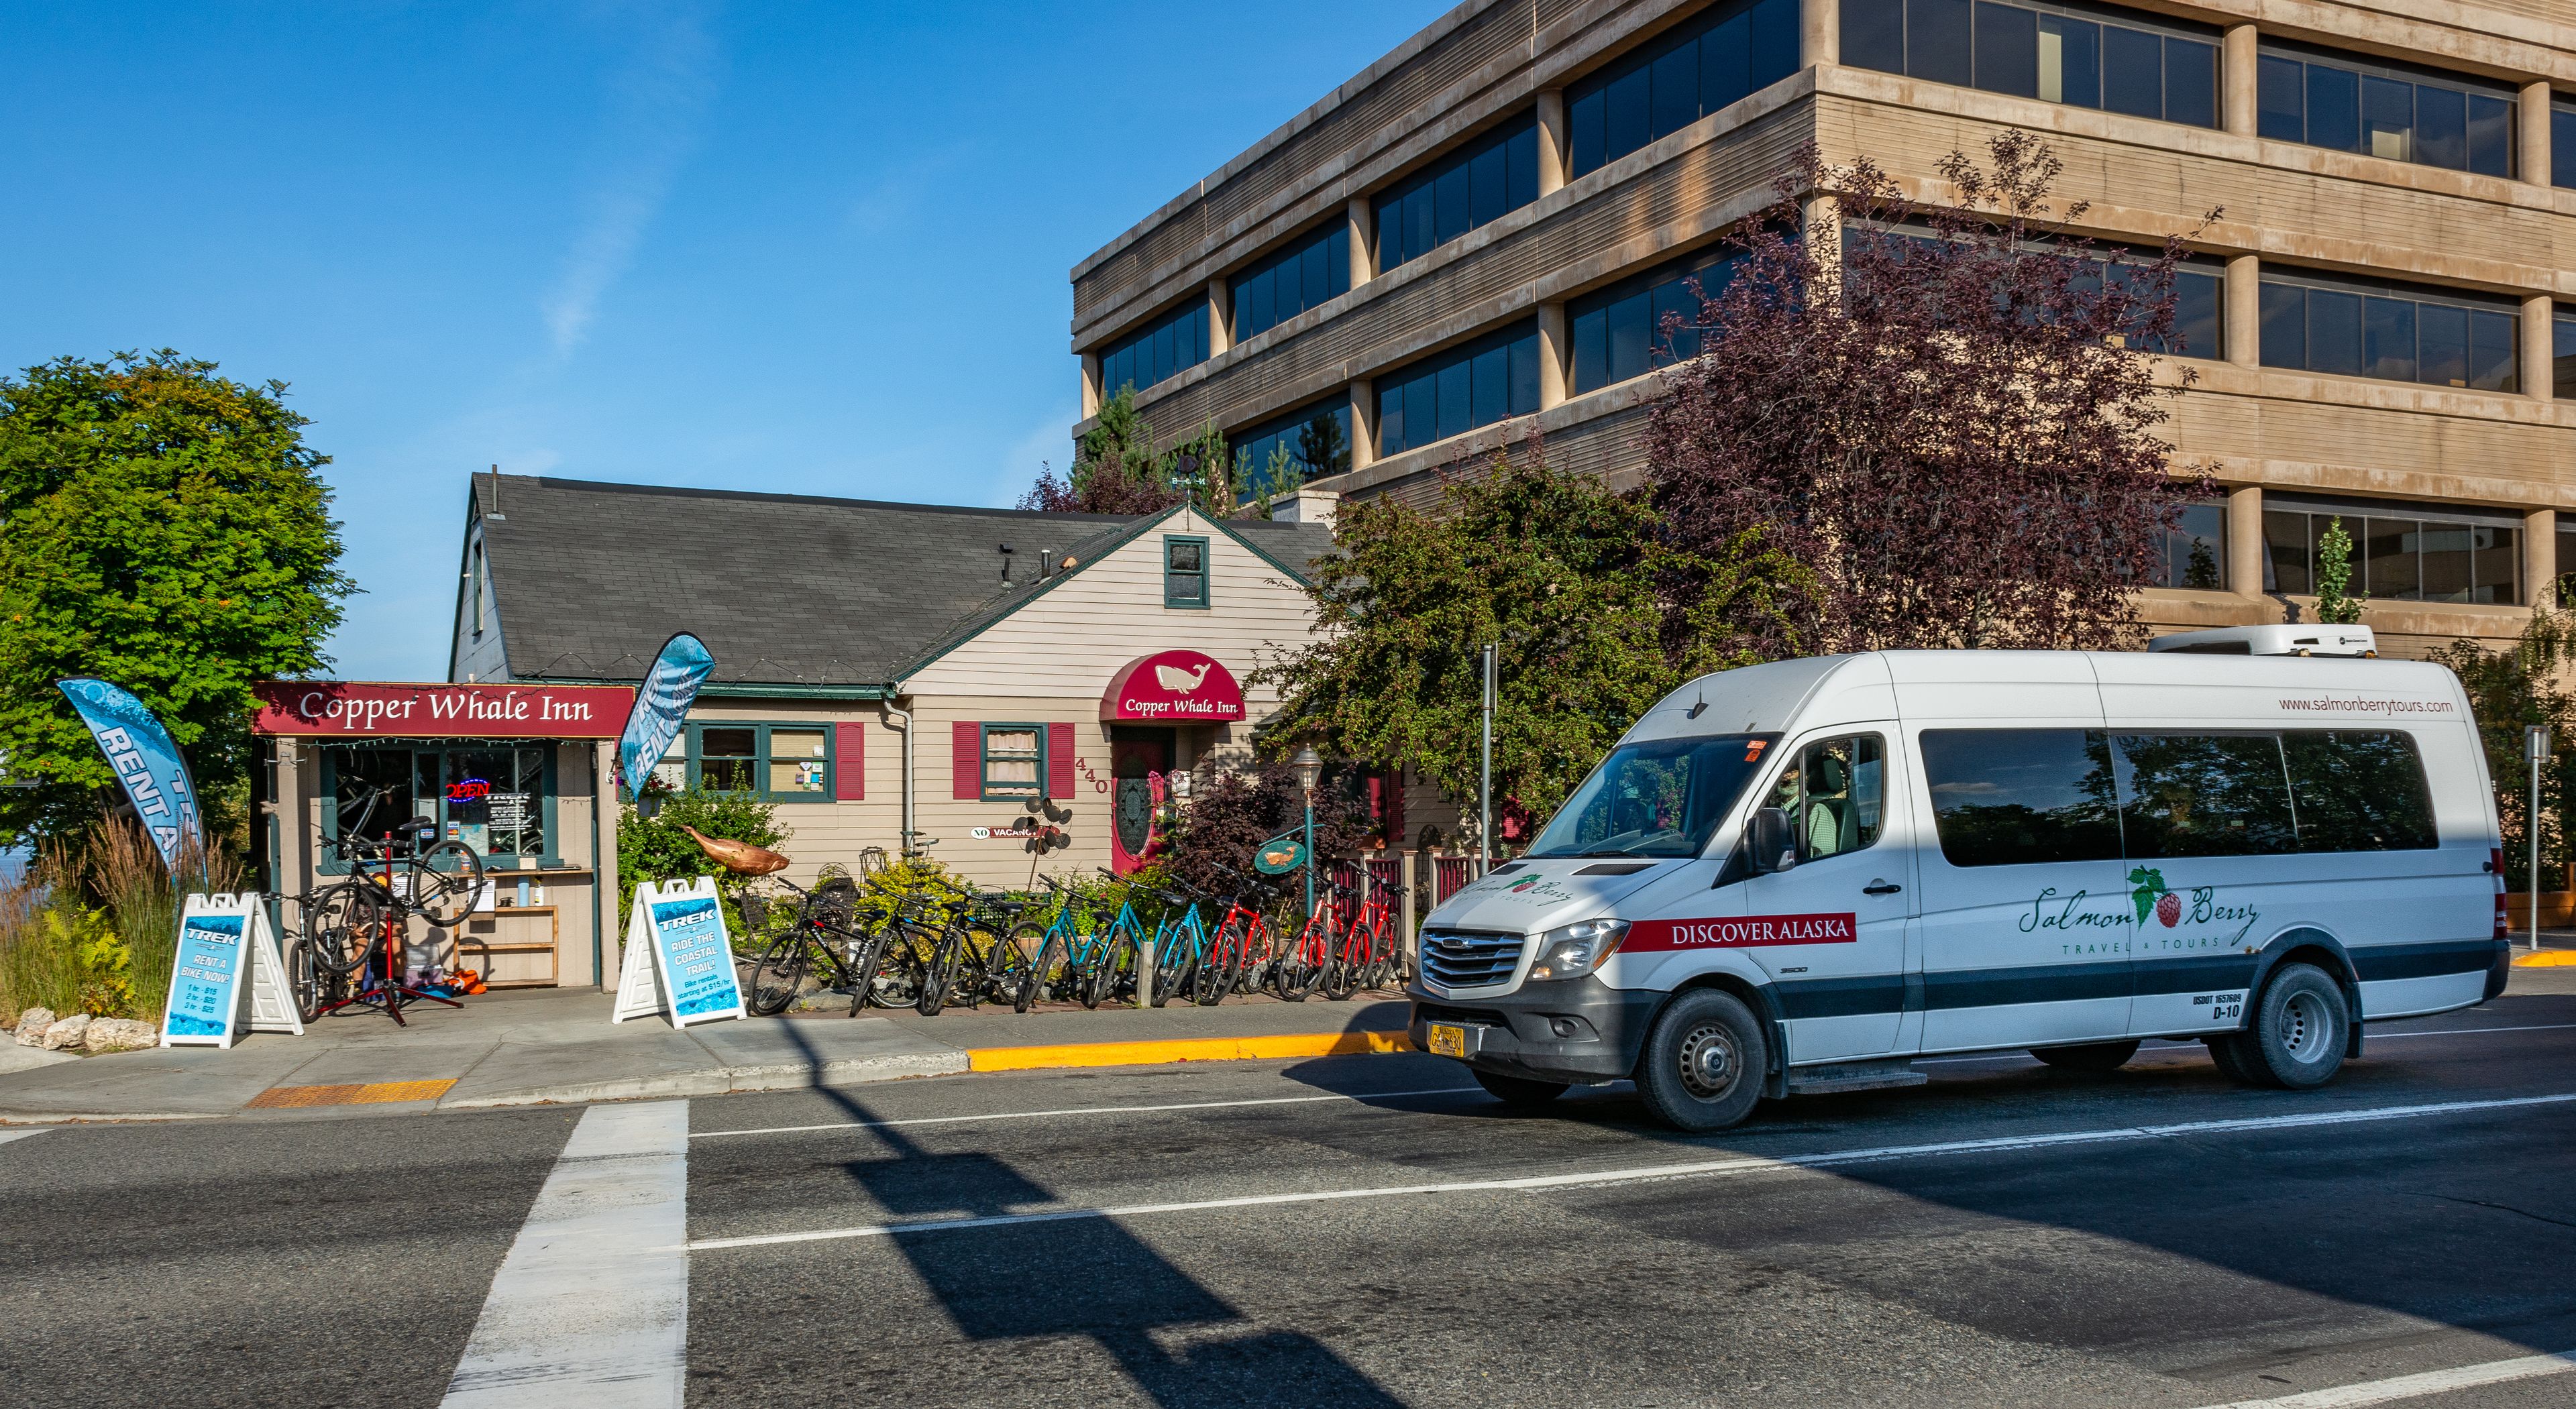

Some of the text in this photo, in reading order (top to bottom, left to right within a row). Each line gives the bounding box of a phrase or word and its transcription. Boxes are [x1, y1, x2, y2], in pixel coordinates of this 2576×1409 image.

[631, 664, 664, 732] TREK
[1126, 699, 1238, 716] Copper Whale Inn
[2279, 695, 2453, 716] www.salmonberrytours.com
[301, 691, 593, 729] Copper Whale Inn
[635, 716, 673, 784] RENT
[1075, 757, 1108, 793] 440
[97, 726, 178, 852] RENT A
[445, 783, 490, 798] OPEN
[659, 909, 716, 932] TREK
[2019, 885, 2261, 947] Salmon Berry
[186, 928, 239, 946] TREK
[1671, 919, 1849, 944] DISCOVER ALASKA
[671, 931, 716, 953] RIDE THE
[2062, 942, 2131, 955] TRAVEL
[2161, 938, 2218, 950] TOURS
[193, 954, 227, 970] RENT A
[674, 945, 718, 966] COASTAL
[180, 966, 231, 984] BIKE NOW!
[685, 959, 716, 977] TRAIL!
[684, 974, 718, 988] Bike rentals
[678, 988, 701, 999] starting
[2193, 995, 2213, 1005] USDOT
[2213, 1004, 2240, 1019] D-10
